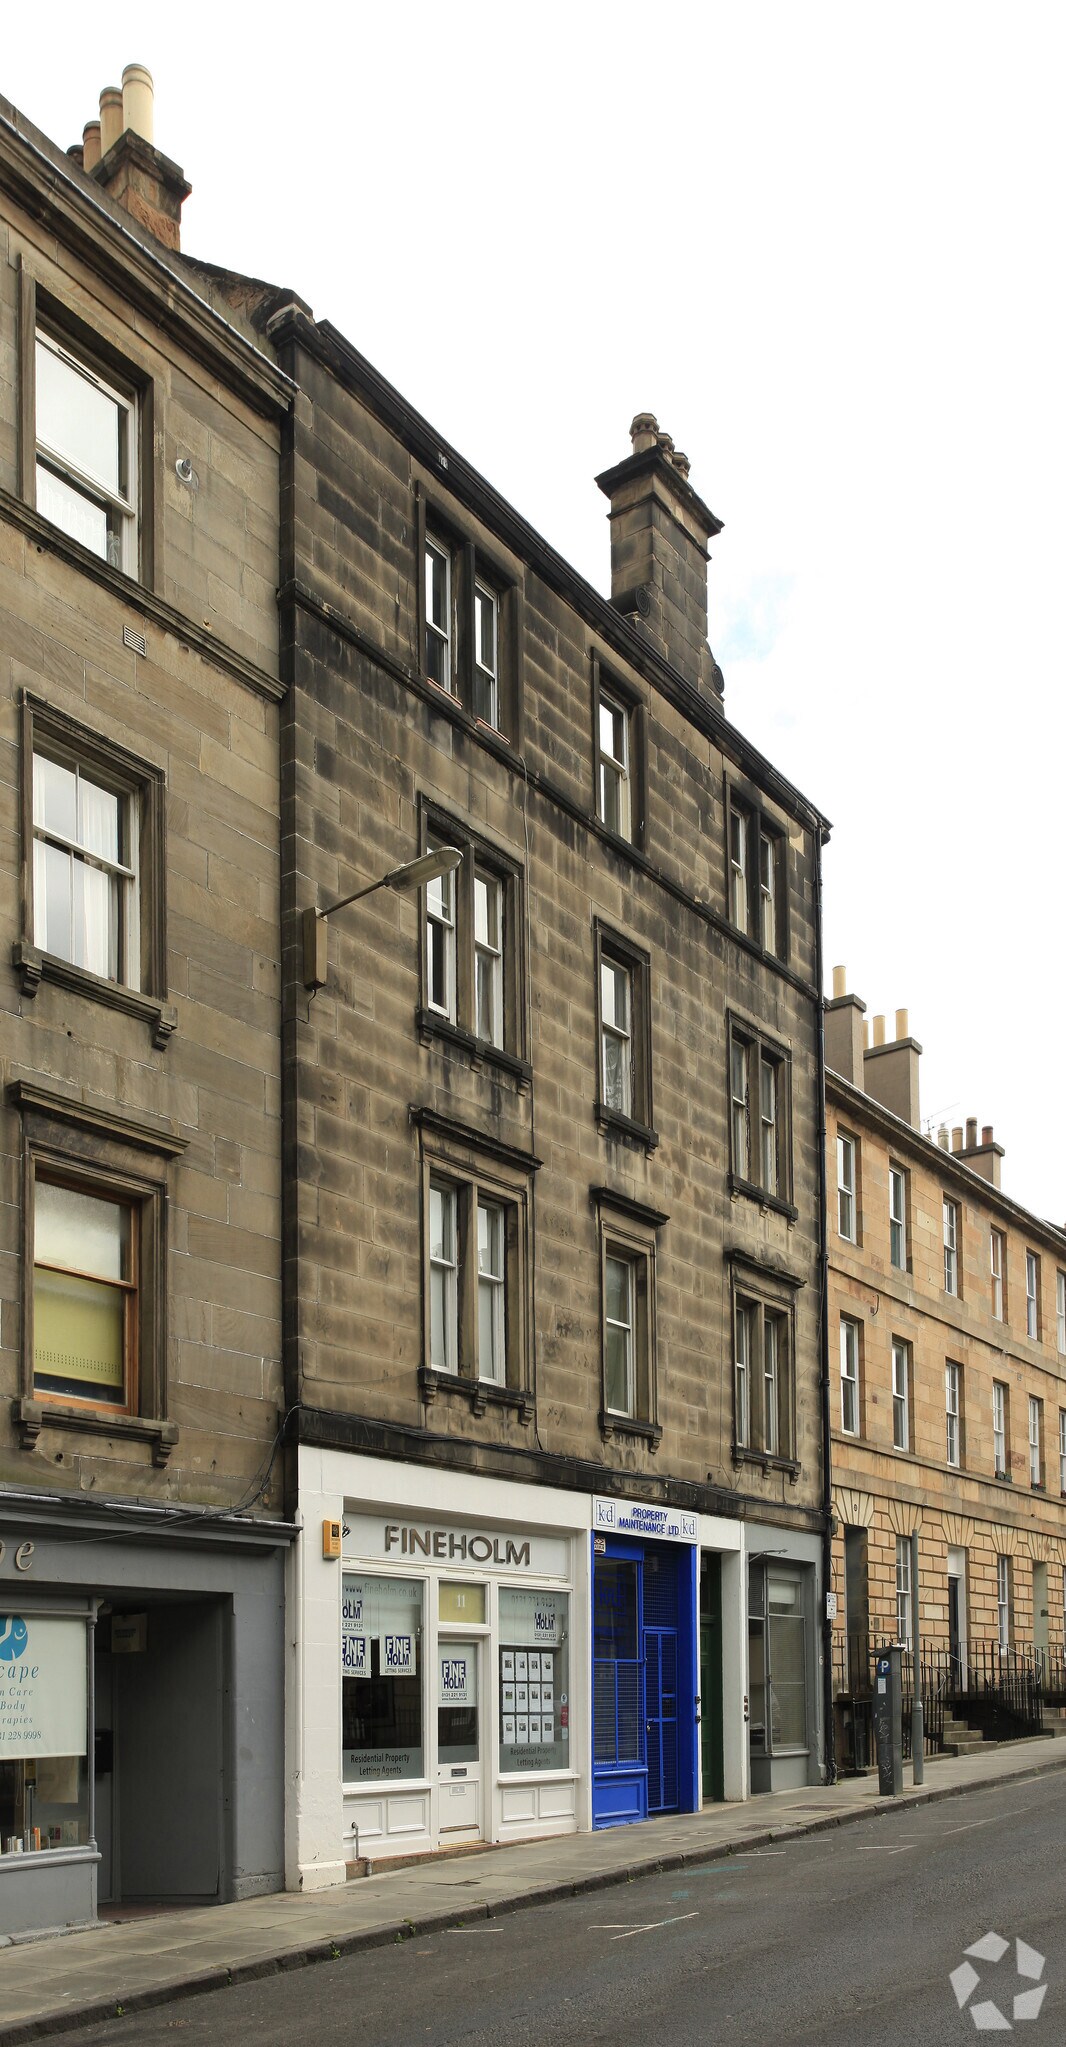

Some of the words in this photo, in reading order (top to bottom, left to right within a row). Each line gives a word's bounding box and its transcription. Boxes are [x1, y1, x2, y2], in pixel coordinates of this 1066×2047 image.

[632, 1507, 669, 1522] PROPERTY
[618, 1517, 666, 1534] MAINTENANCE
[385, 1525, 530, 1567] FINEHOLM
[457, 1594, 466, 1608] 11
[536, 1619, 554, 1630] HOLM
[386, 1635, 410, 1655] FINE
[386, 1653, 410, 1666] HOLM
[443, 1661, 466, 1679] FINE
[881, 1660, 889, 1673] P
[443, 1677, 465, 1689] HOLM
[9, 1687, 34, 1696] Care
[0, 1700, 26, 1712] Body
[8, 1731, 21, 1740] 228
[24, 1730, 41, 1740] 9998
[510, 1746, 536, 1756] Residential
[351, 1753, 384, 1763] Residential
[385, 1753, 410, 1764] Property
[516, 1758, 533, 1768] Letting
[534, 1758, 551, 1767] Agents
[360, 1765, 380, 1777] Letting
[382, 1765, 402, 1777] Agents
